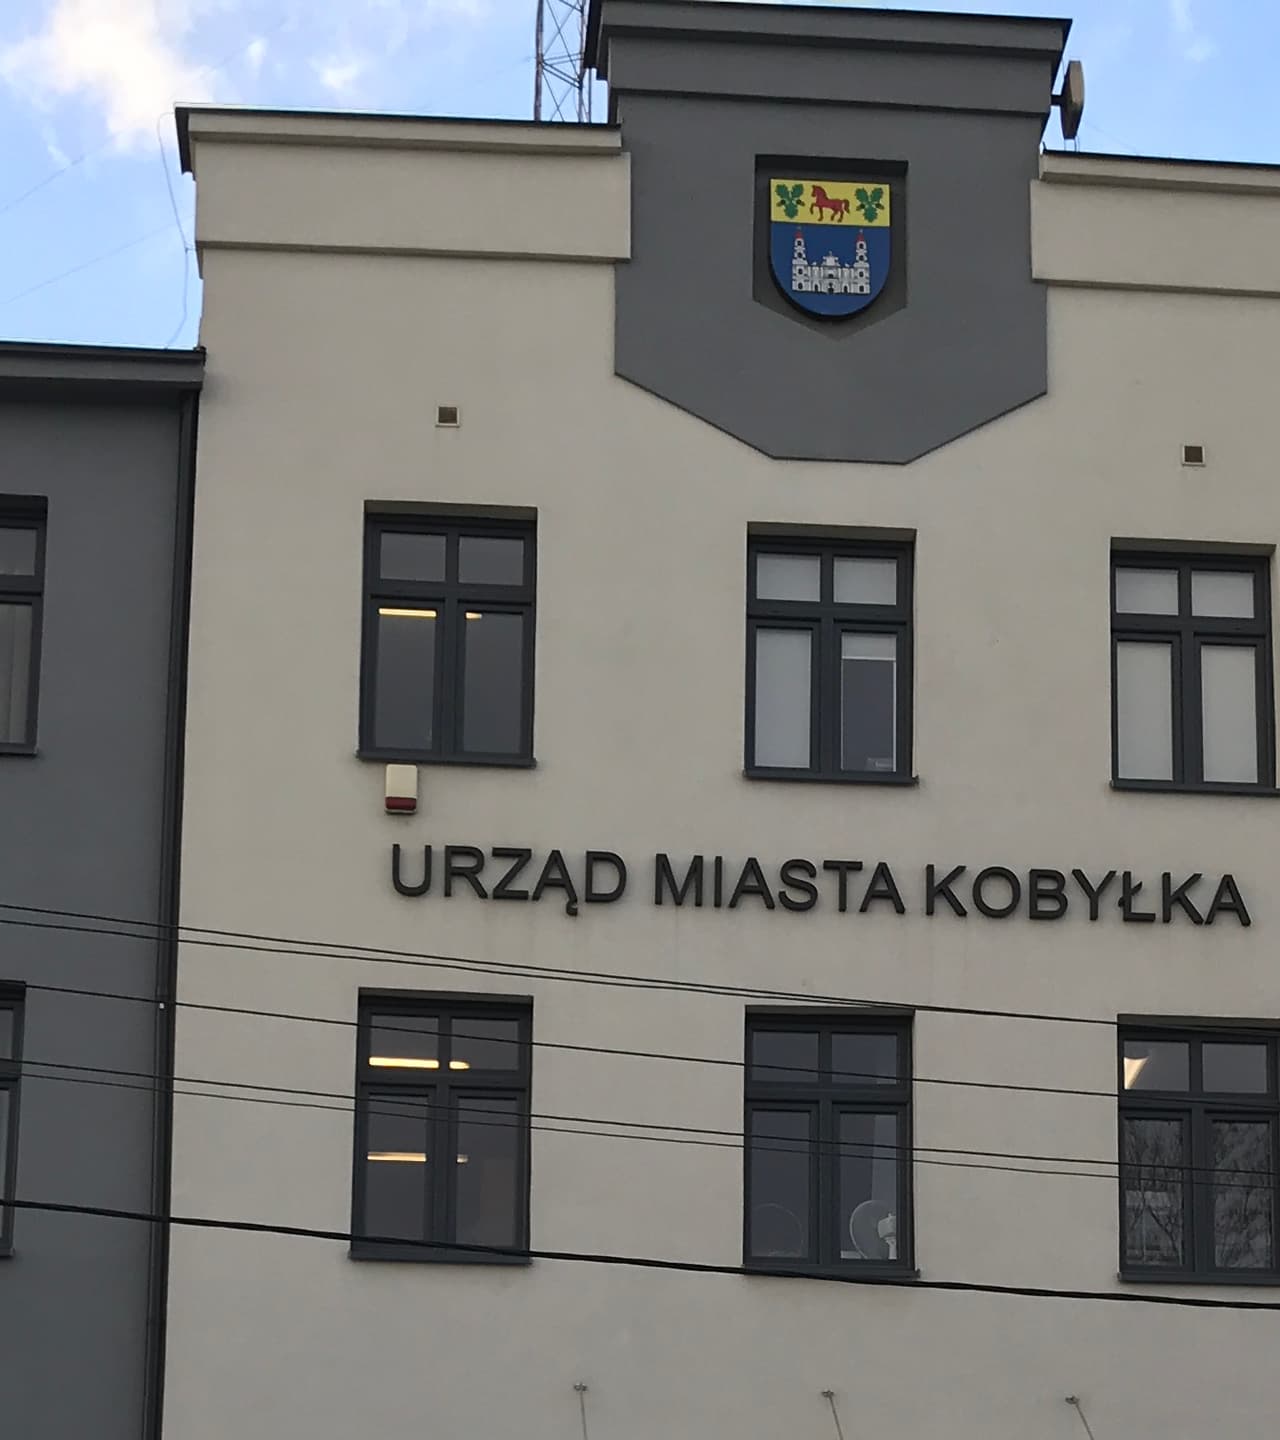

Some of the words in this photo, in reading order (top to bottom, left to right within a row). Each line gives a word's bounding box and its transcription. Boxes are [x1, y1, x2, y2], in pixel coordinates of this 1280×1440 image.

[391, 843, 628, 917] URZĄD
[654, 853, 906, 915] MIASTA
[925, 864, 1252, 928] KOBYŁKA
